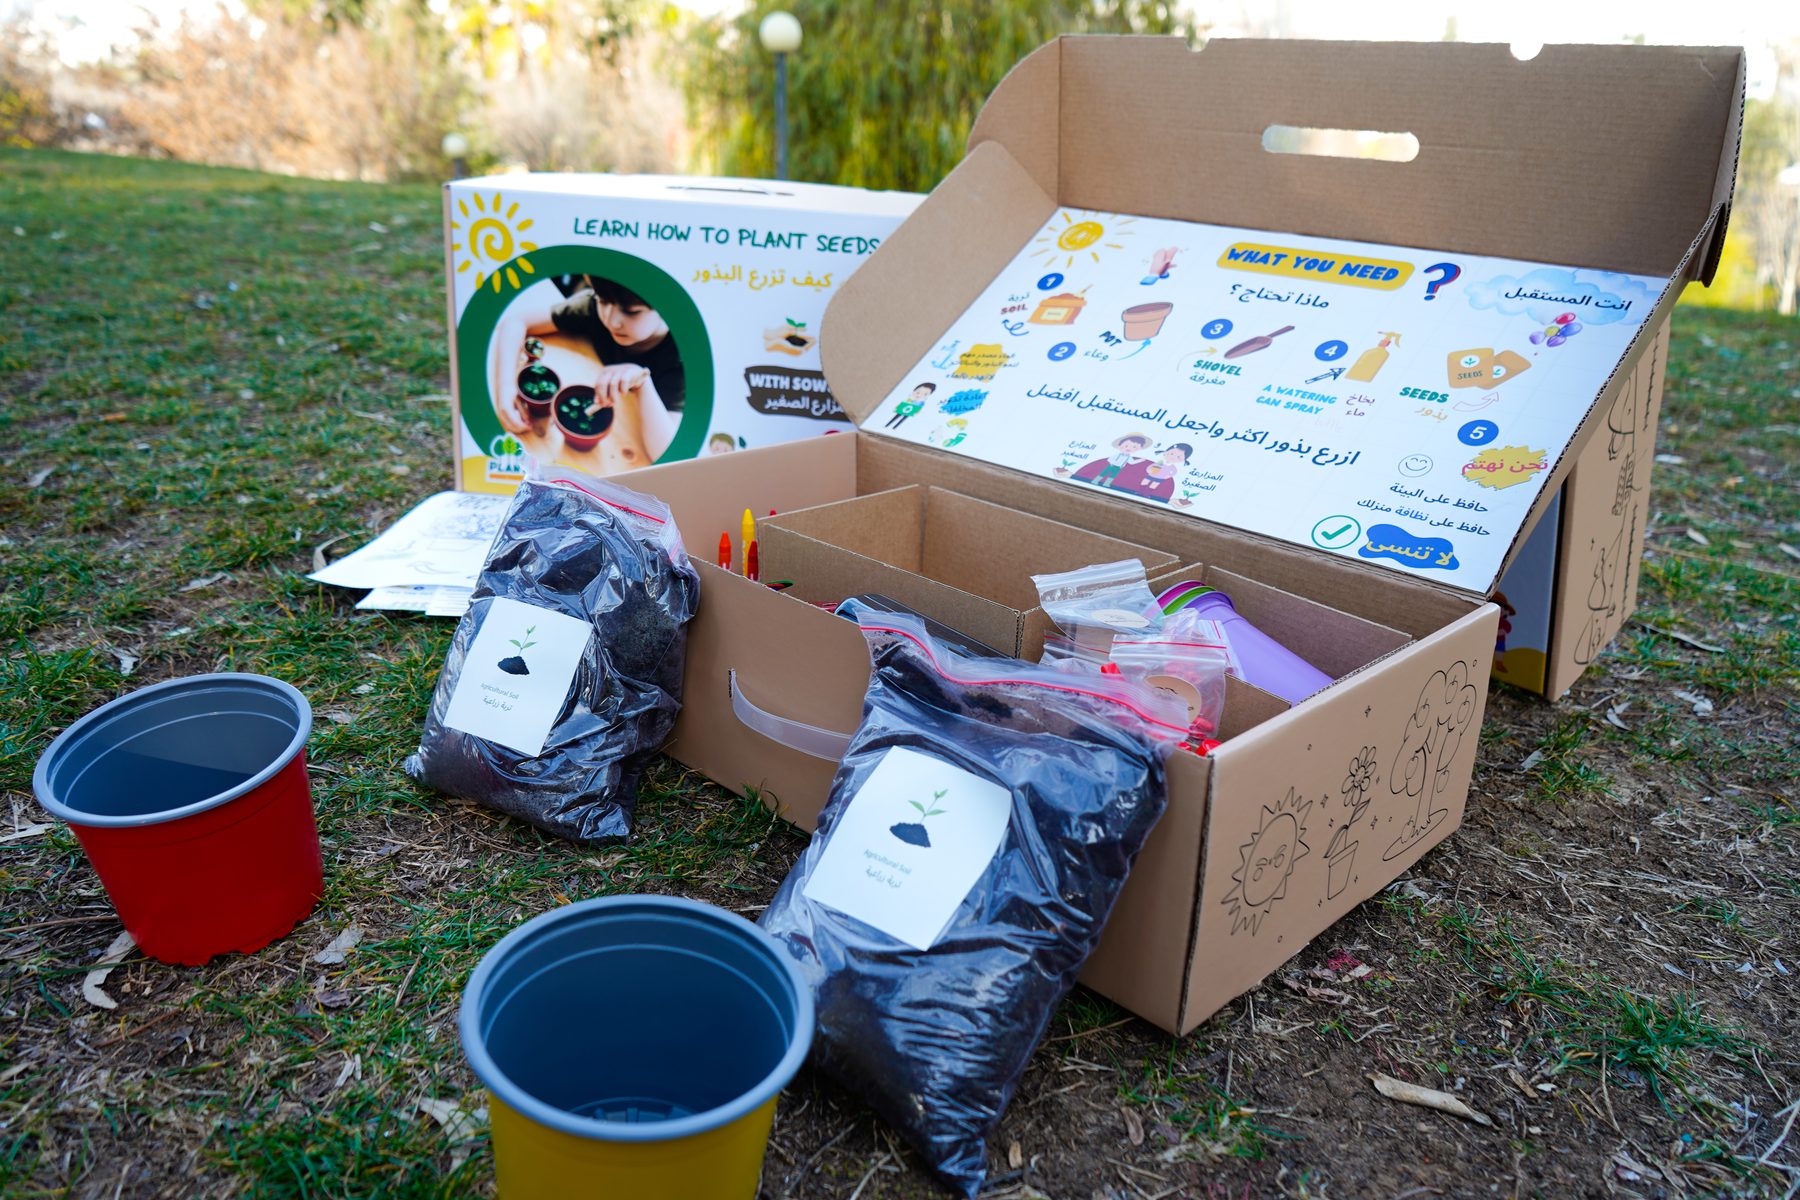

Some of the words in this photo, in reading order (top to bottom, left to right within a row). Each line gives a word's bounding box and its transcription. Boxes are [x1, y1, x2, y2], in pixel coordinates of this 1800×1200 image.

[573, 217, 639, 238] LEARN
[647, 222, 691, 241] HOW
[699, 226, 730, 245] TO
[738, 229, 808, 250] PLANT
[691, 263, 743, 283] البذور
[1227, 248, 1288, 267] WHAT
[1292, 255, 1335, 273] YOU
[1339, 263, 1399, 282] NEED
[748, 268, 786, 290] تزرع
[790, 272, 833, 293] كيف
[1295, 292, 1329, 308] ماذا
[1504, 287, 1593, 306] المستقبل
[1594, 298, 1633, 311] انت
[1000, 303, 1028, 315] SOIL
[1210, 323, 1225, 335] 3
[1054, 346, 1069, 358] 2
[1323, 345, 1339, 358] 4
[1193, 359, 1242, 376] SHOVEL
[1456, 370, 1484, 380] SEEDS
[748, 373, 790, 390] WITH
[792, 376, 832, 393] SOW
[1026, 383, 1078, 402] افضل
[1262, 384, 1272, 393] A
[1276, 386, 1338, 405] WATERING
[1399, 386, 1450, 404] SEEDS
[764, 393, 810, 410] الصغير
[1076, 392, 1166, 423] المستقبل
[1255, 396, 1280, 407] CAN
[1284, 401, 1324, 416] SPRAY
[1346, 407, 1366, 418] ماء
[1414, 407, 1448, 423] بذور
[1164, 414, 1225, 439] واجعل
[1469, 426, 1488, 440] 5
[1224, 427, 1269, 445] اكثر
[1265, 437, 1312, 458] بذور
[1311, 446, 1361, 466] ازرع
[489, 462, 526, 473] PLAN
[1461, 458, 1505, 475] نهتم
[1509, 459, 1549, 473] نحن
[1389, 482, 1424, 499] البيئة
[1423, 491, 1450, 505] على
[1356, 498, 1392, 513] منزلك
[1394, 505, 1429, 522] نظافة
[1452, 498, 1489, 514] حافظ
[1429, 515, 1454, 529] على
[1456, 522, 1491, 537] حافظ
[1365, 540, 1435, 561] تنسى
[1435, 550, 1454, 566] لا
